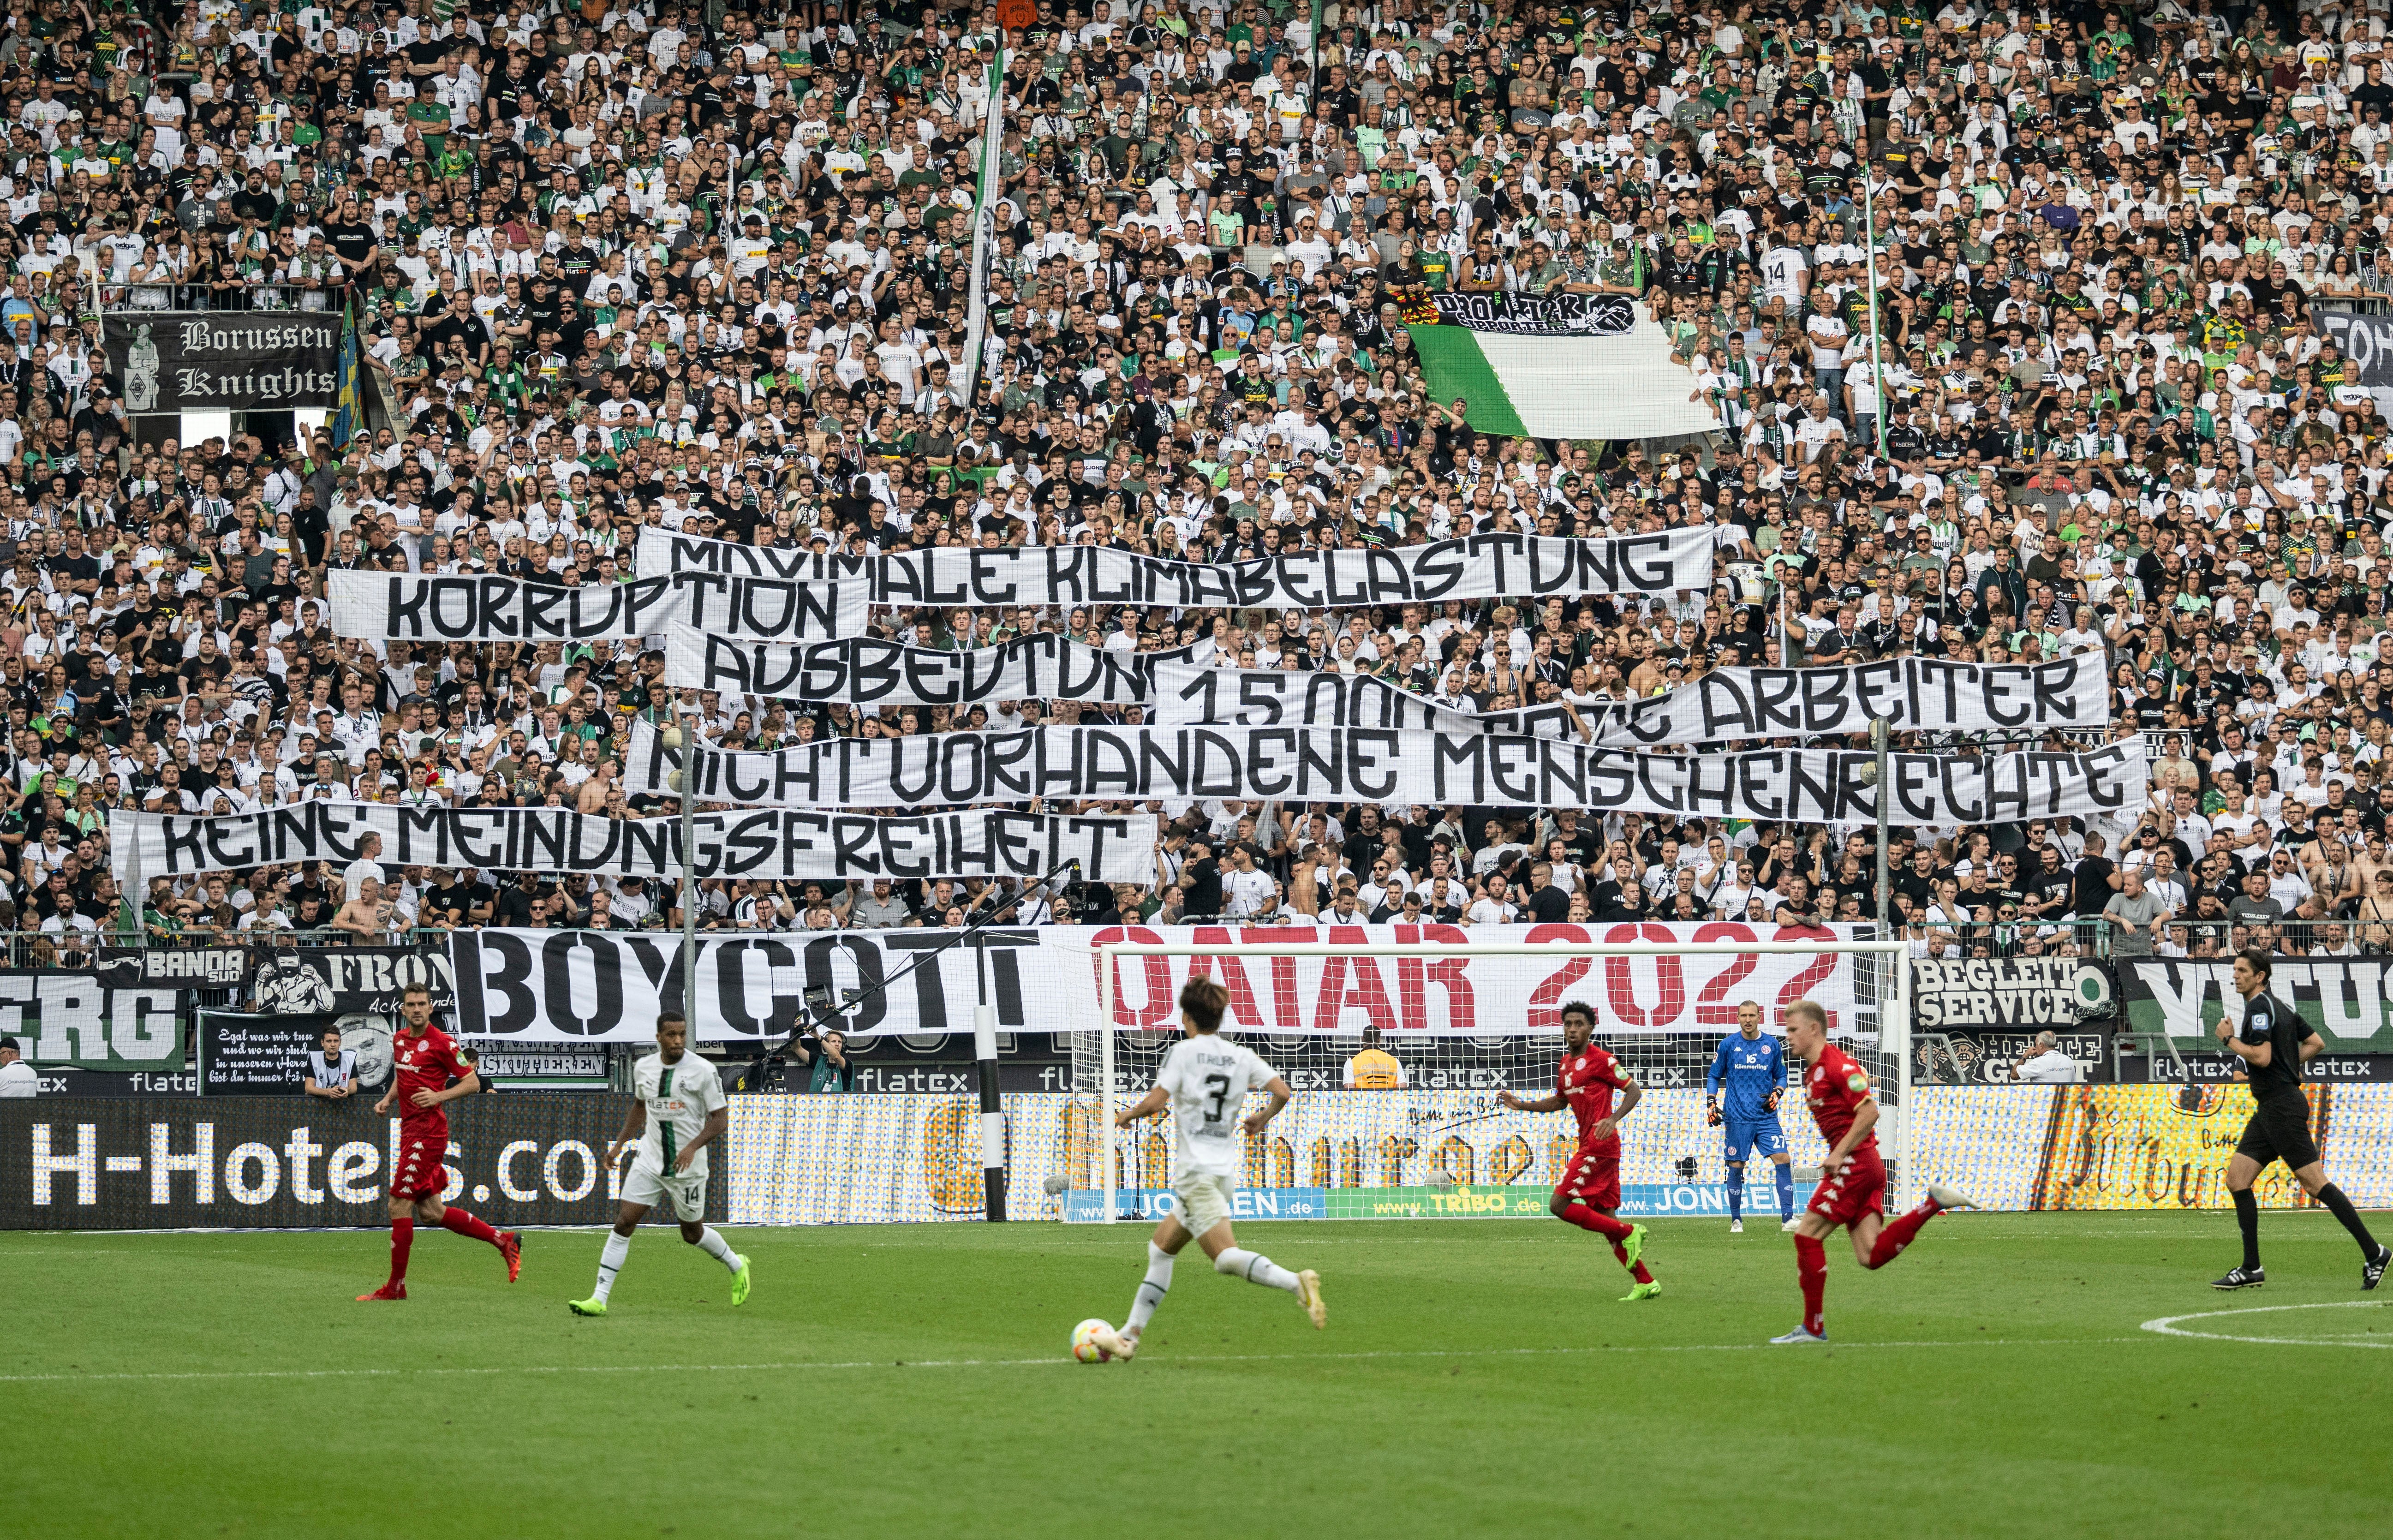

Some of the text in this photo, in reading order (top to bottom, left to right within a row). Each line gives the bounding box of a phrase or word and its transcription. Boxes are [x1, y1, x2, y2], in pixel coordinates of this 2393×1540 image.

[1768, 261, 1785, 284] 14
[180, 321, 334, 355] Borussen
[176, 367, 337, 399] Knights
[1046, 533, 1674, 607] KLIMABELASTUNG
[387, 571, 838, 639] KORRUPTION
[1699, 658, 2078, 738] ARBEITER
[1434, 732, 2125, 821] MENSCHENRECHTE
[162, 806, 1128, 881] KEINE MEINUNGSFREIHEIT
[451, 929, 1040, 1036] BOYCOTT
[1090, 924, 1475, 1031] QATAR
[1911, 958, 2079, 993] BEGLEIT
[1918, 989, 2075, 1027] SERVICE
[219, 1029, 248, 1044] Egal
[251, 1032, 270, 1041] was
[273, 1031, 290, 1041] wir
[223, 1045, 243, 1056] und
[267, 1045, 285, 1056] wir
[216, 1058, 228, 1068] in
[1204, 1074, 1229, 1122] 3
[1771, 1135, 1786, 1149] 27
[685, 1185, 699, 1205] 14
